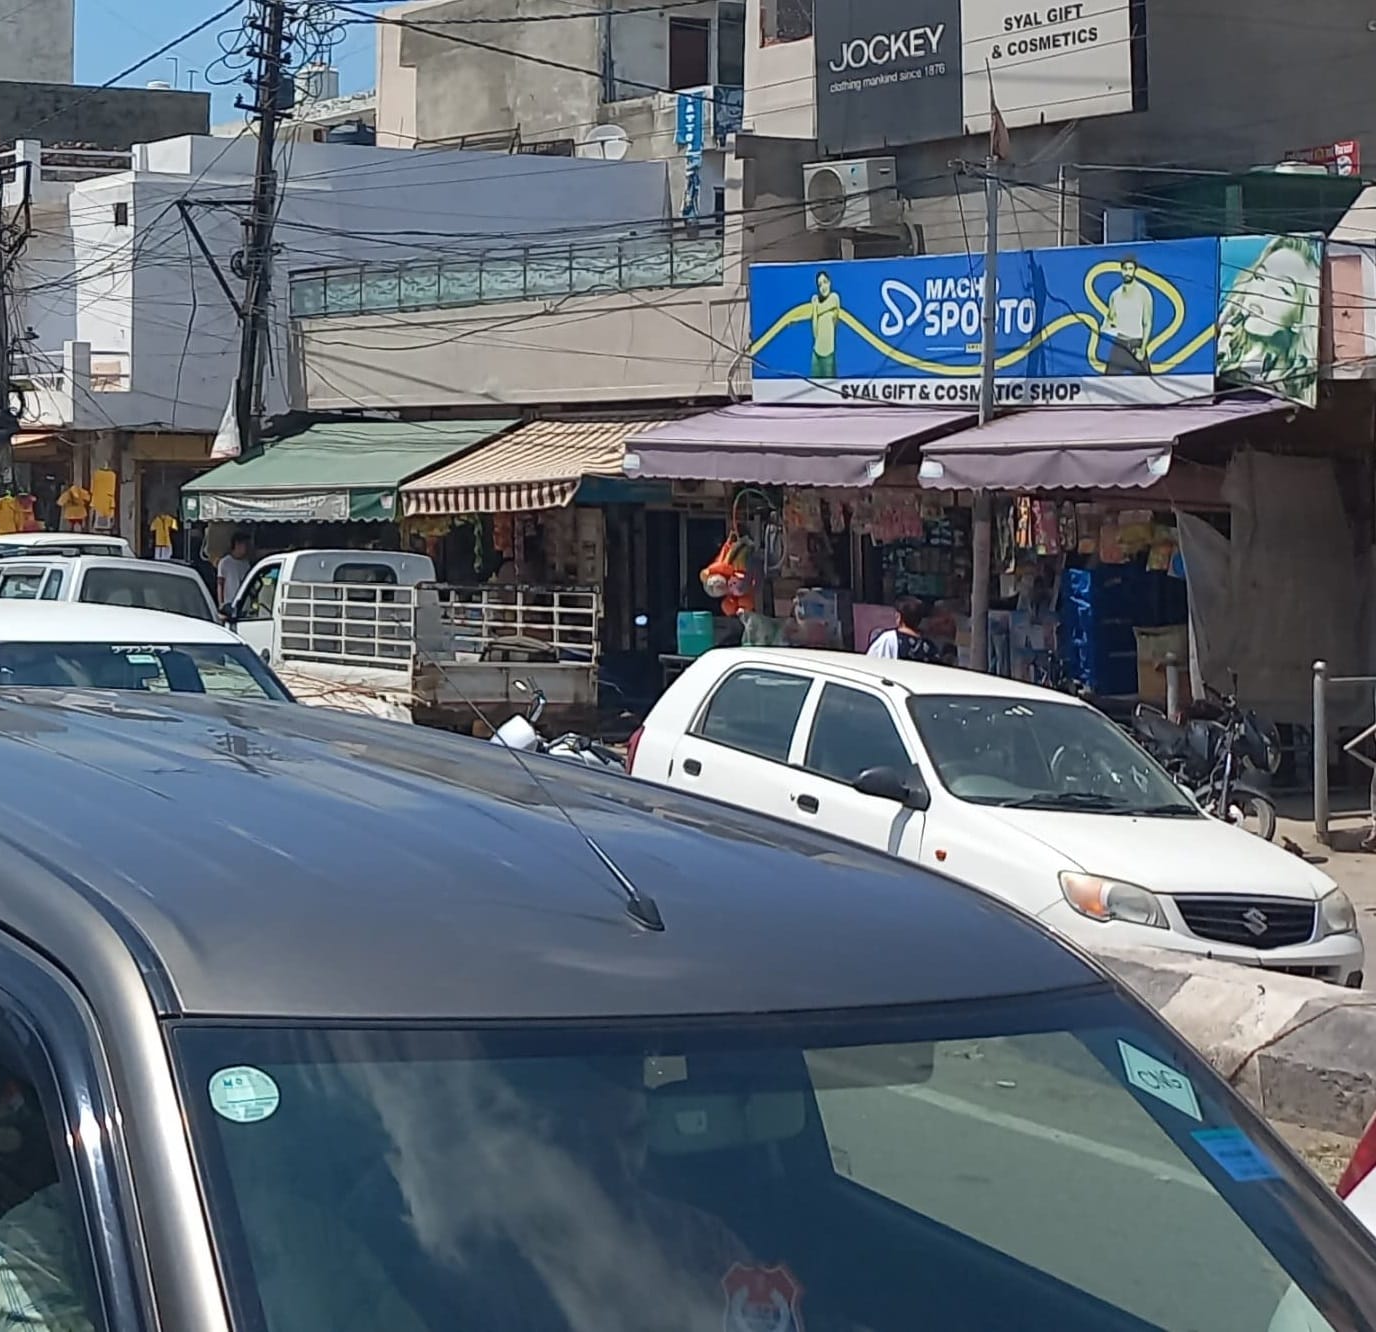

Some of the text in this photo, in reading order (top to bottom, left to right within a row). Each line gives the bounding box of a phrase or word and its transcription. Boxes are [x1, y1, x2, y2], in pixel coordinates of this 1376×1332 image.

[1003, 4, 1083, 32] SYAL GIFT
[829, 24, 944, 72] JOCKEY
[991, 27, 1098, 60] & COSMETICS
[830, 63, 946, 94] clothing mankind since 1876
[925, 298, 1036, 337] SPOTO
[841, 383, 1081, 401] SYAL GIFT & COSMTIC SHOP
[1137, 1070, 1183, 1089] CNG
